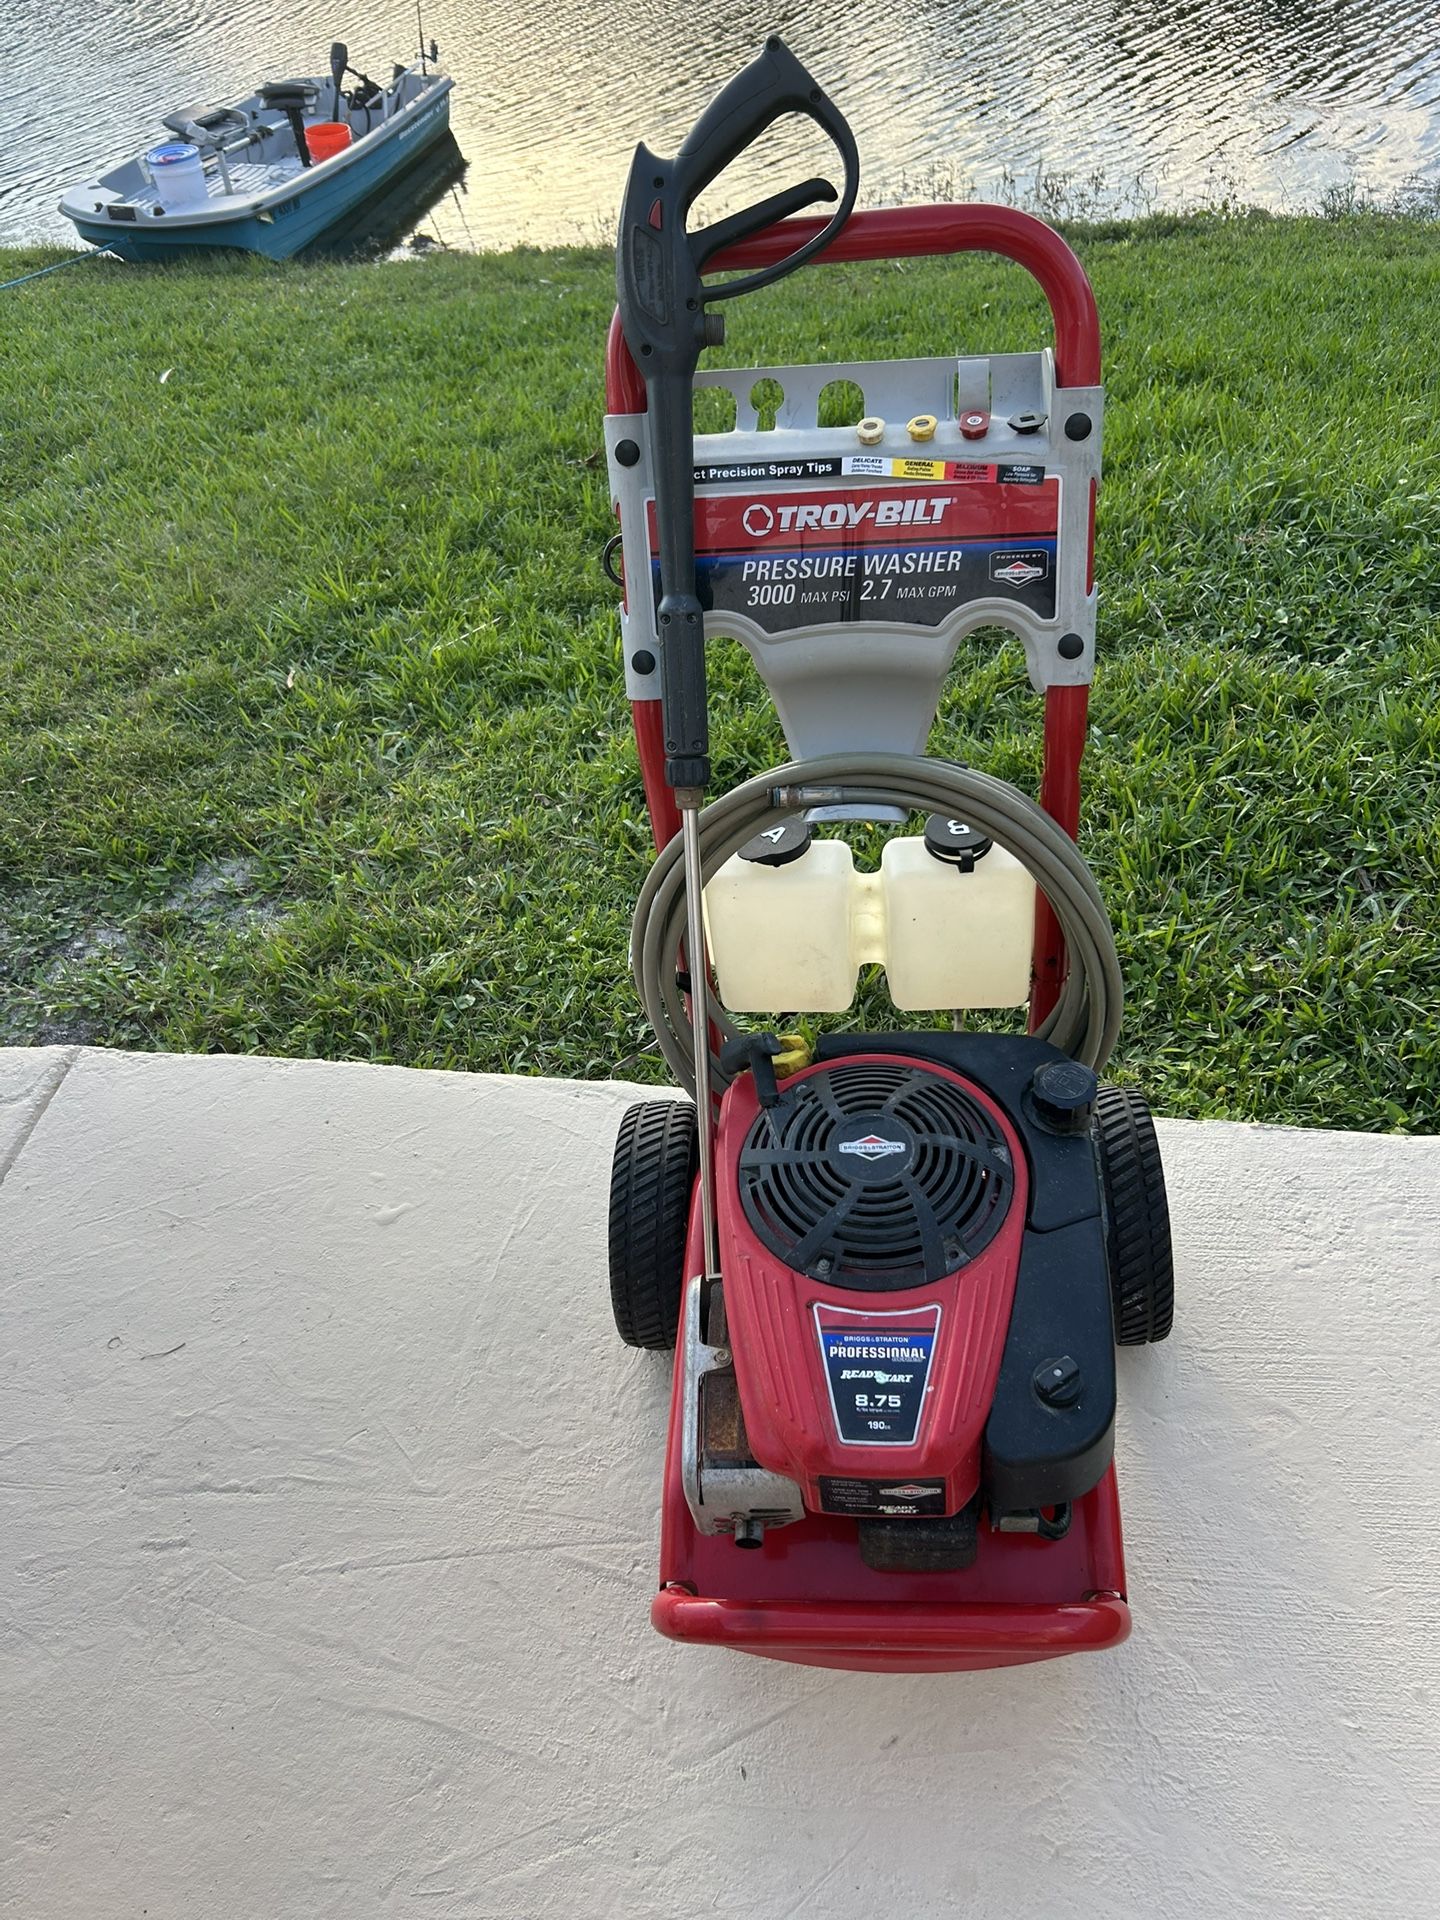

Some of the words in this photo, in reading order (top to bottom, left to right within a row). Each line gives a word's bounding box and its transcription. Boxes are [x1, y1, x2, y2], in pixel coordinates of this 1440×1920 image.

[709, 466, 766, 479] Precision
[769, 464, 804, 477] Spray
[806, 462, 833, 475] Tips
[904, 460, 935, 468] GENERAL
[776, 497, 952, 532] TROY-BILT
[742, 556, 858, 581] PRESSURE
[863, 550, 963, 575] WASHER
[747, 584, 796, 606] 3000
[800, 592, 829, 604] MAX
[831, 591, 851, 602] PSI
[860, 579, 893, 600] 2.7
[896, 587, 925, 599] MAX
[928, 585, 957, 597] GPM
[760, 825, 786, 844] A
[829, 1346, 926, 1359] PROFESSIONAL
[855, 1393, 902, 1408] 8.75
